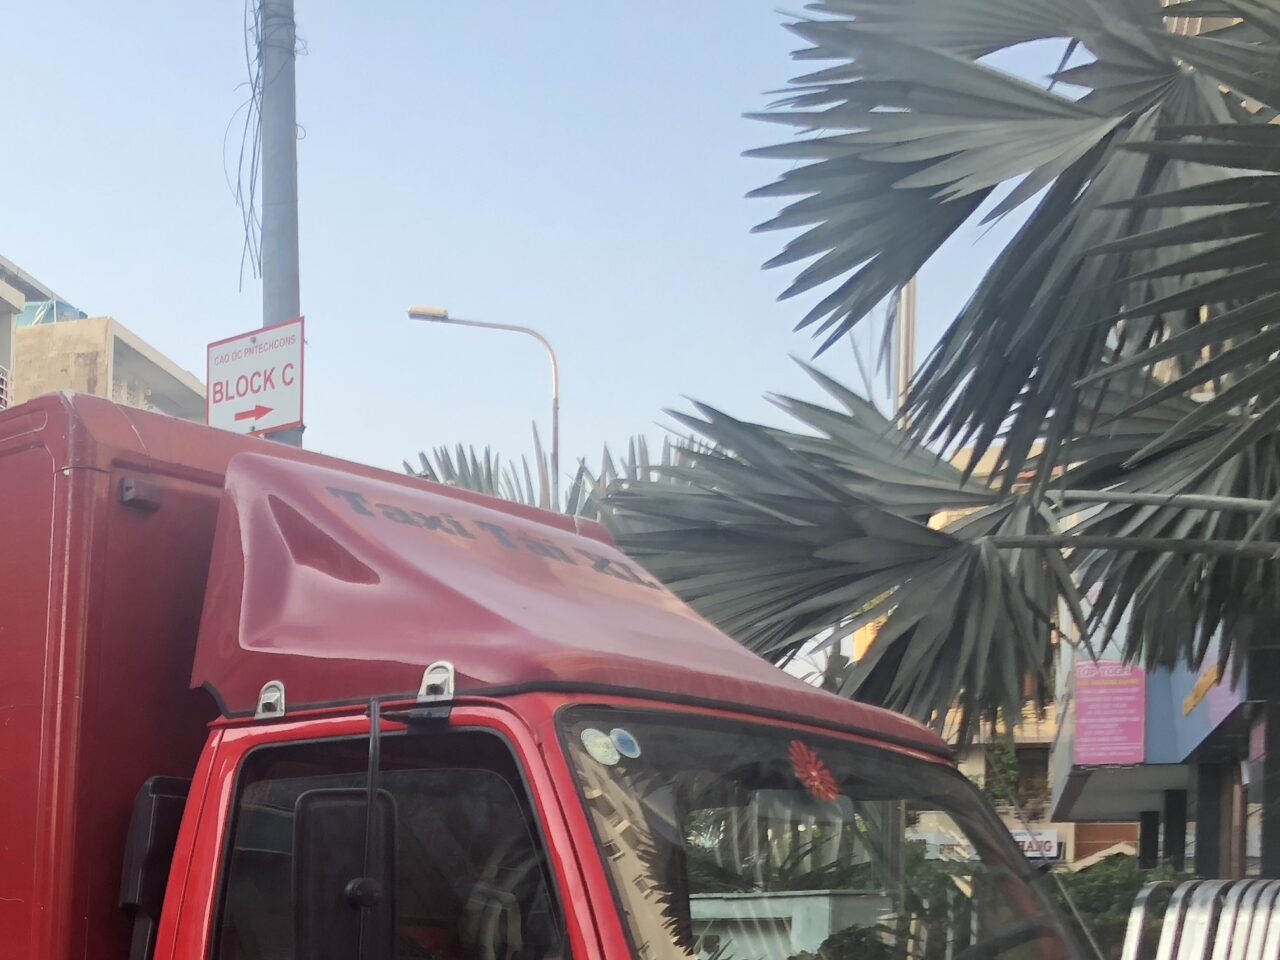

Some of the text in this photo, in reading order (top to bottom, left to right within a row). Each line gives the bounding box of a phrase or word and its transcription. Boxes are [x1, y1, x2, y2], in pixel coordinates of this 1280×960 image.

[214, 353, 230, 366] CAO
[213, 363, 294, 404] BLOCK C
[325, 486, 477, 540] Taxi
